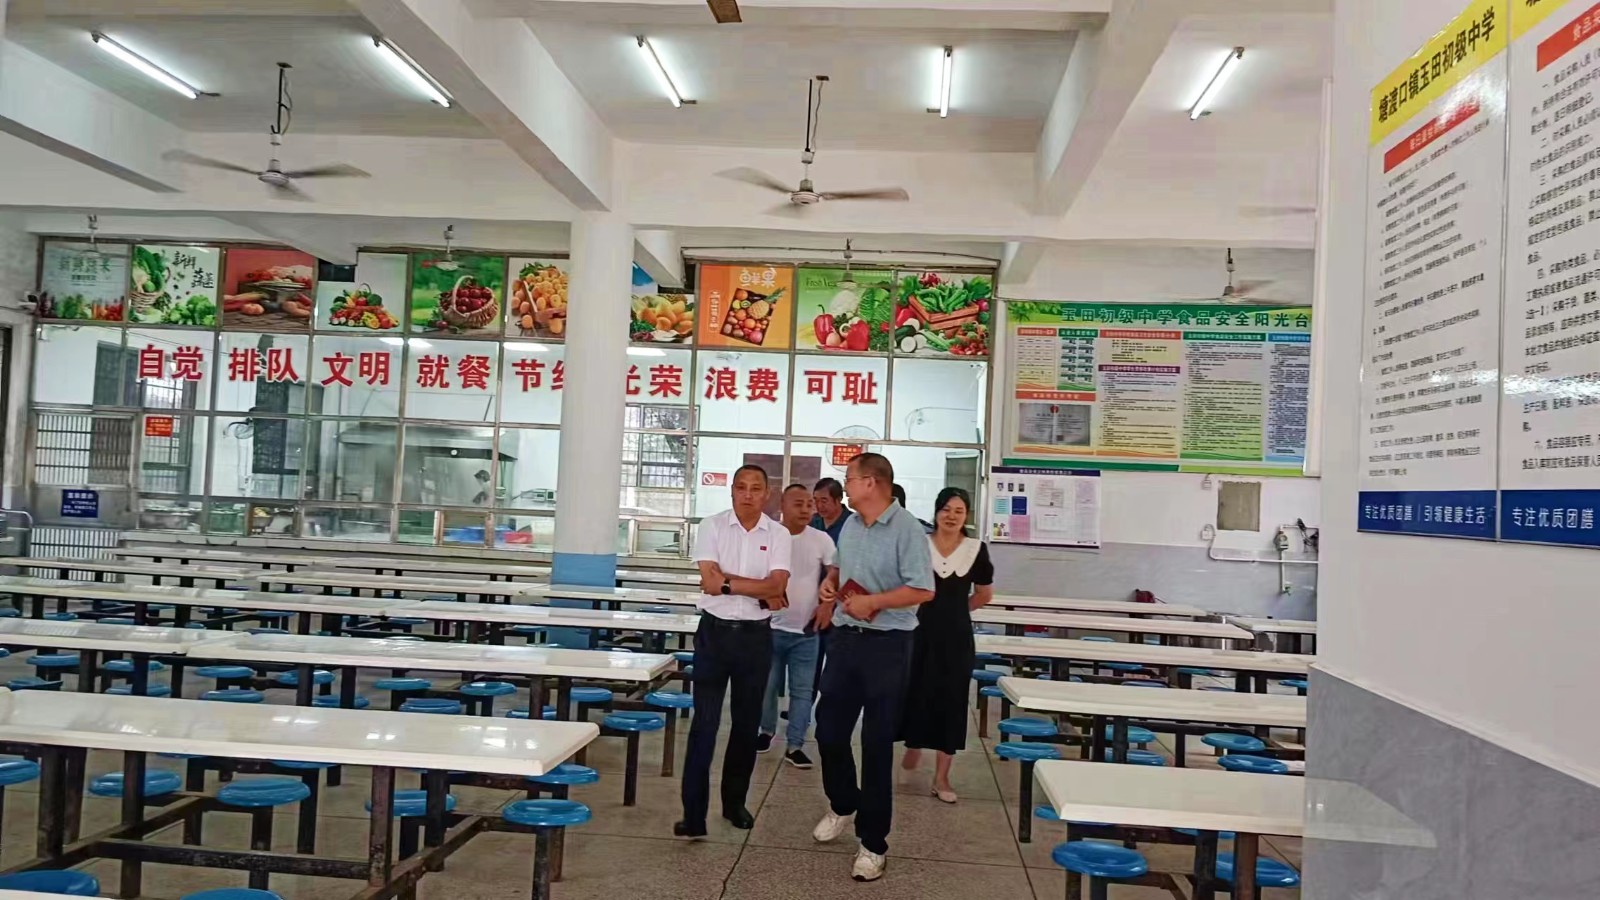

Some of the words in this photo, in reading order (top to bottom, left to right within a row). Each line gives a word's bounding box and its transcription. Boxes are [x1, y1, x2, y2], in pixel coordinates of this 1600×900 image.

[1378, 6, 1495, 123] 塘渡口镇玉田初级中学
[1062, 308, 1309, 328] 玉田初级中学食品安全阳光台
[138, 344, 204, 381] 自觉
[229, 349, 299, 383] 排队
[322, 351, 392, 387] 文明
[418, 354, 491, 390] 就餐
[705, 367, 780, 402] 浪费
[805, 369, 878, 405] 可耻
[1365, 504, 1413, 521] 专注优质团膳
[1424, 505, 1486, 524] 引领健康生活
[1512, 507, 1594, 529] 专注优质团膳
